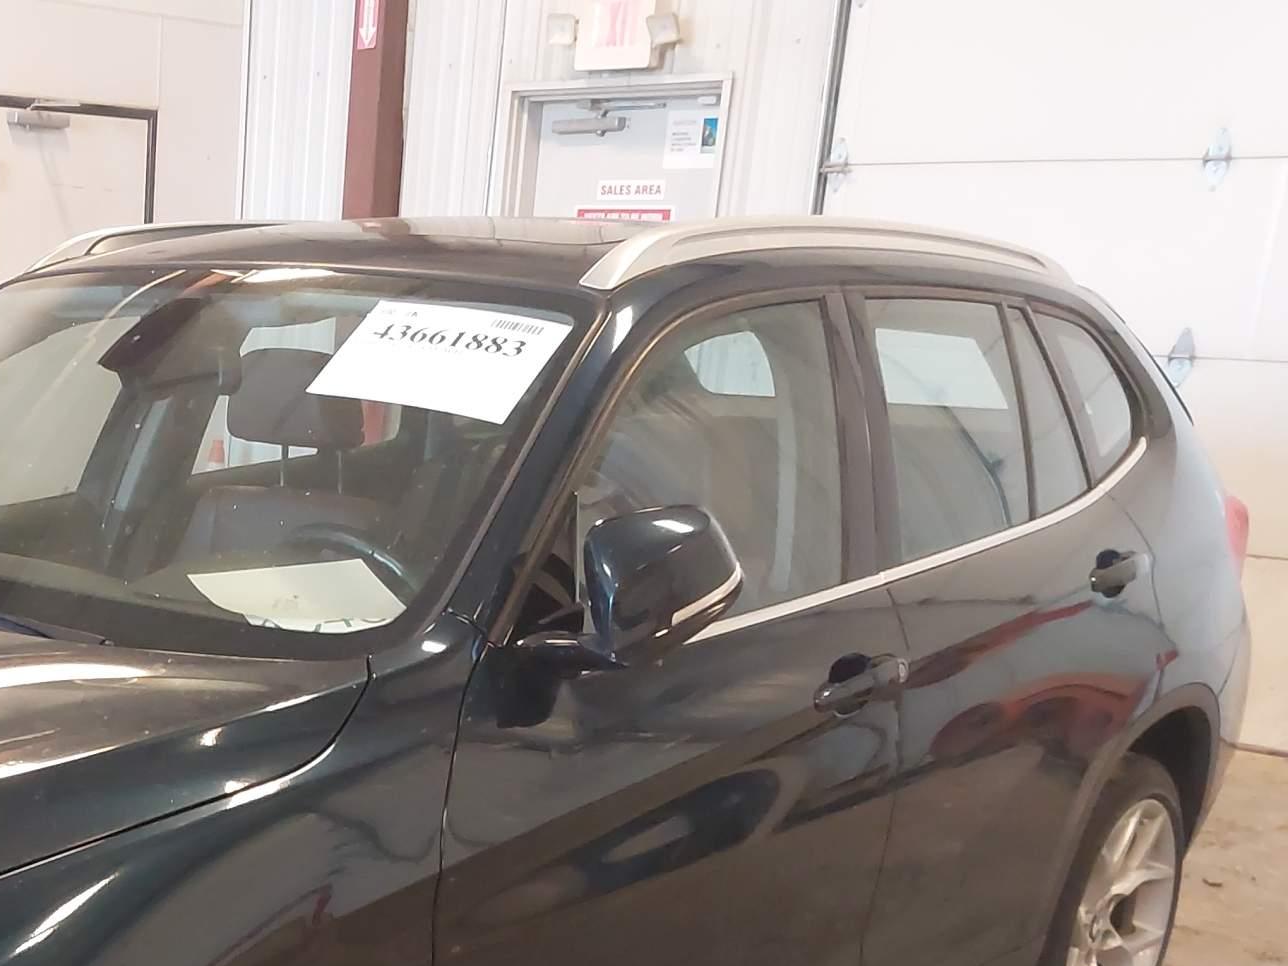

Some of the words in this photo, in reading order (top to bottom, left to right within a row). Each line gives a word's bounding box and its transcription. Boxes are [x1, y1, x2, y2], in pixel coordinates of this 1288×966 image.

[600, 184, 632, 196] SALES
[634, 184, 662, 196] AREA
[373, 323, 527, 357] 43661883
